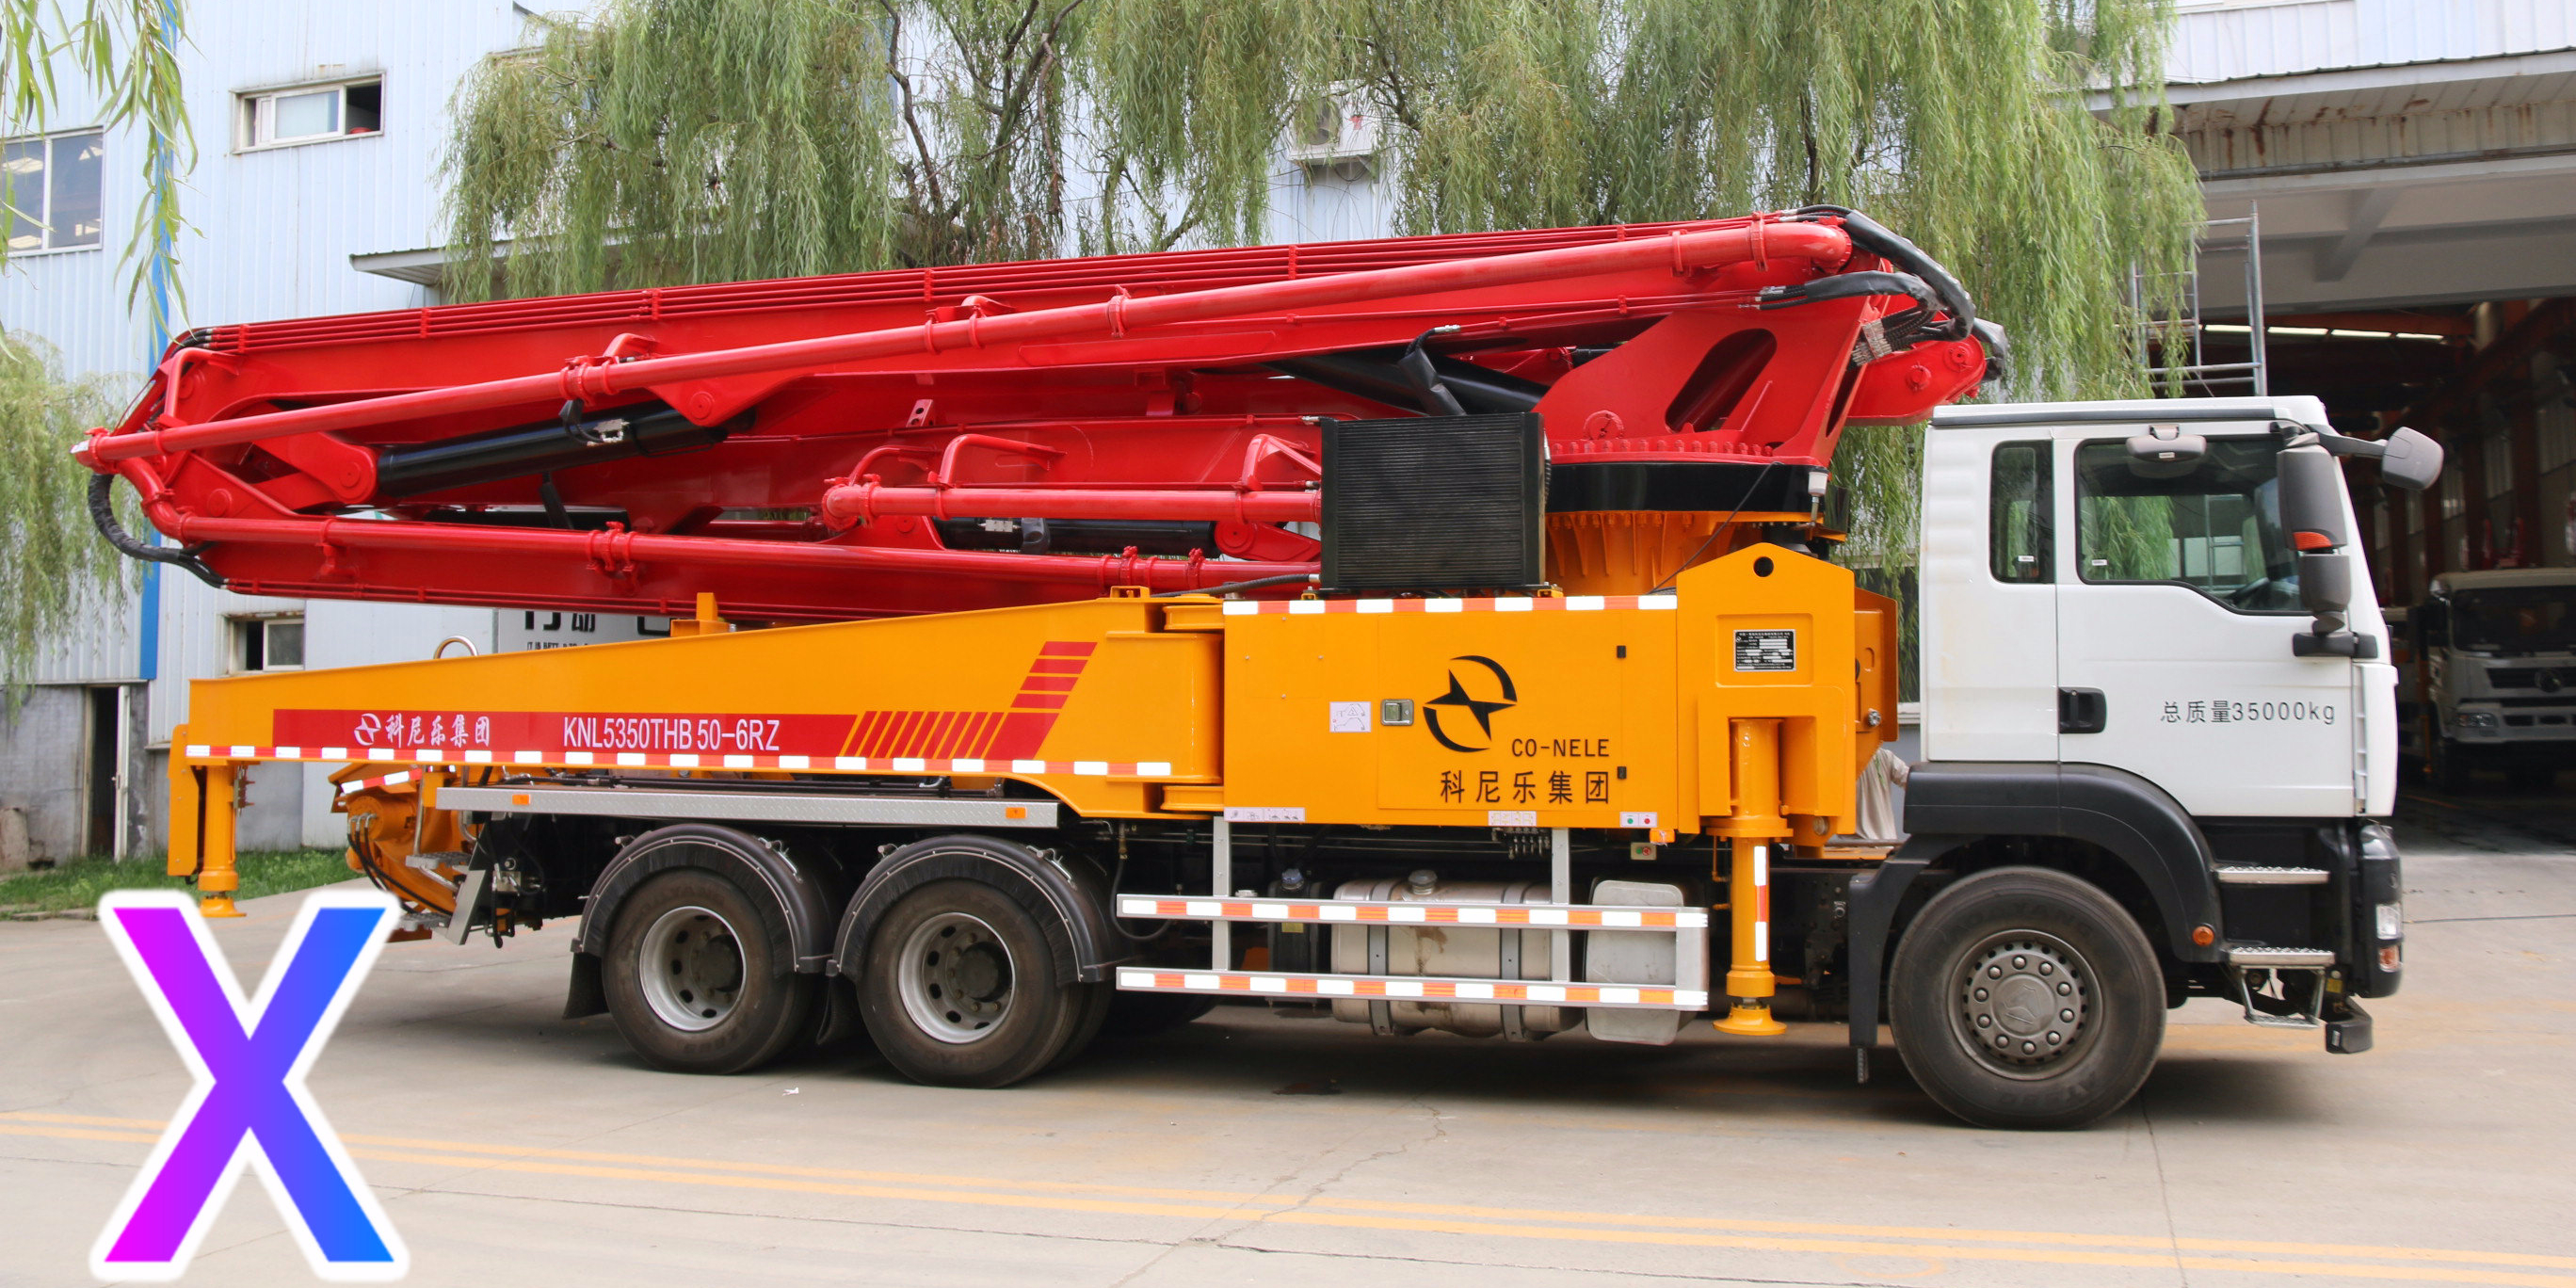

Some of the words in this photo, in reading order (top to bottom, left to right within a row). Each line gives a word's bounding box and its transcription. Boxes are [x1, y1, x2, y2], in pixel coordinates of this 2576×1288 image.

[2161, 700, 2335, 724] 总质量35000kg
[385, 713, 490, 749] 科尼乐集团
[564, 716, 692, 749] KNL5350THB
[697, 718, 780, 751] 50-6RZ
[1511, 738, 1610, 757] CO-NELE
[1441, 770, 1609, 804] 科尼乐集团
